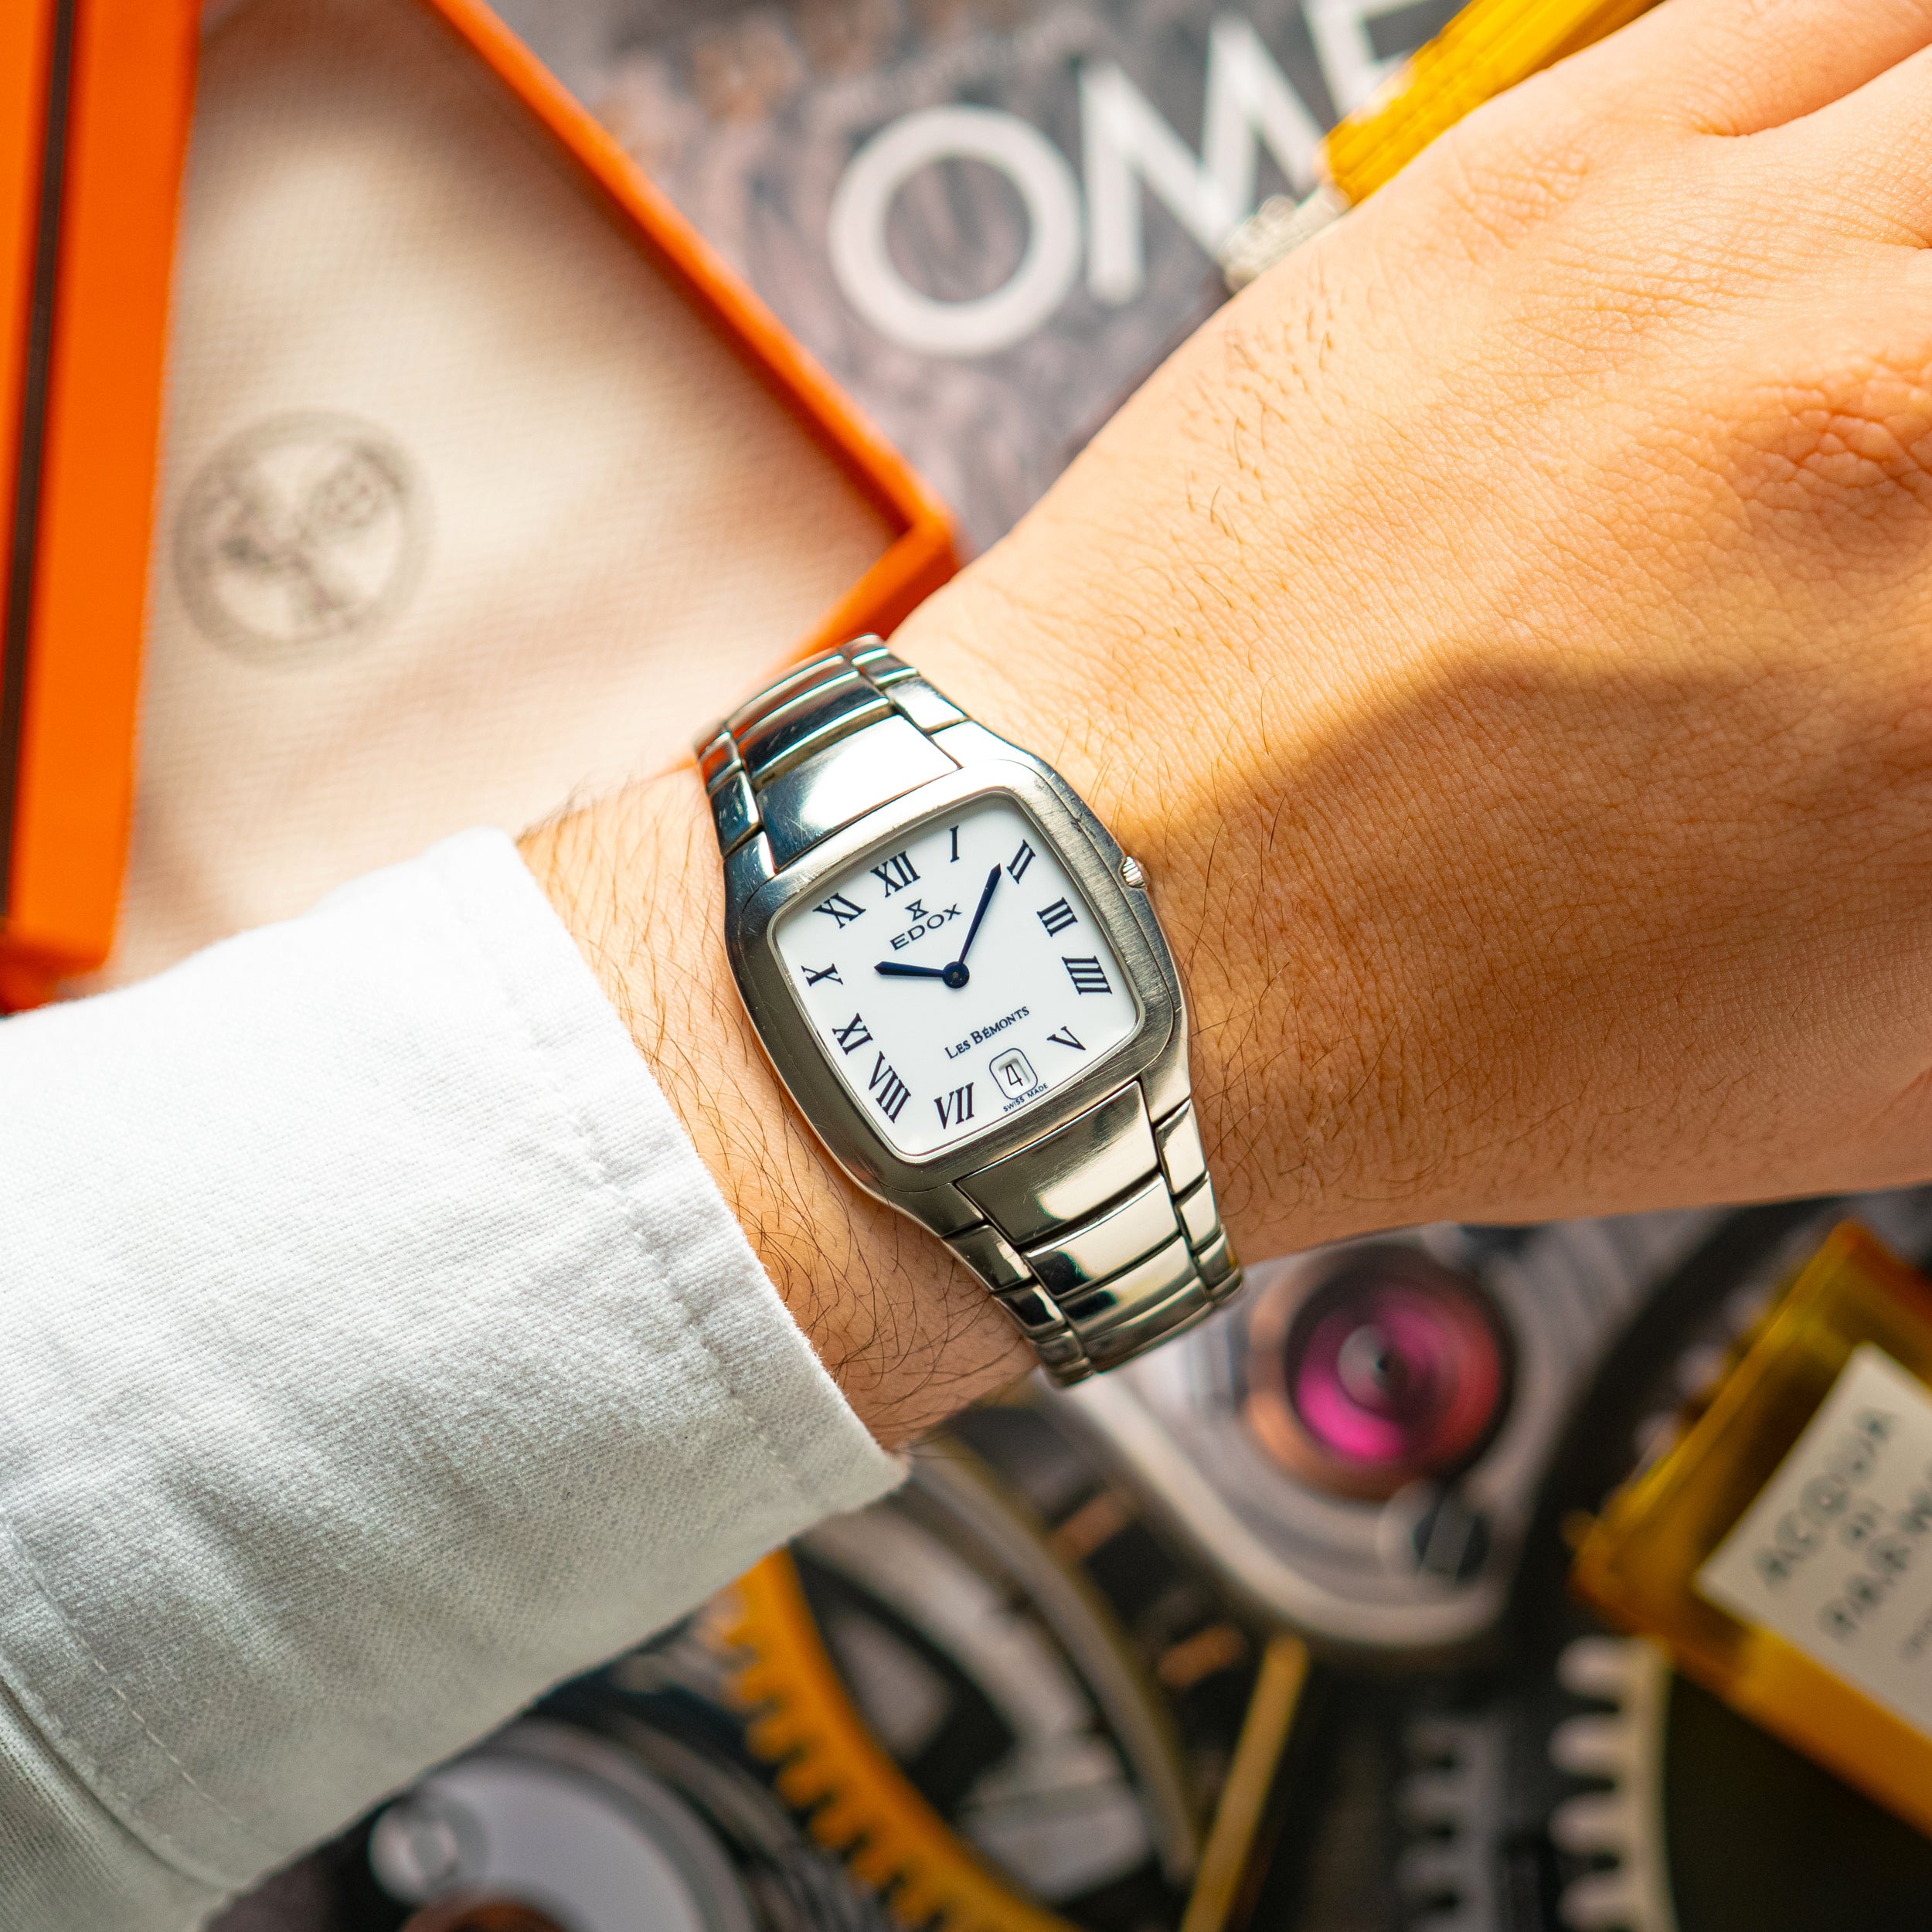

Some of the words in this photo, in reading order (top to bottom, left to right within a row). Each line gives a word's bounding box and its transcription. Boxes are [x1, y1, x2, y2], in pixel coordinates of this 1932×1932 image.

[869, 850, 921, 898] XII
[1006, 838, 1036, 885] II
[812, 893, 866, 929] XI
[889, 903, 963, 951] EDOX
[1036, 896, 1079, 938] III
[801, 963, 844, 988] X
[1061, 954, 1113, 995] IIII
[1046, 1026, 1087, 1051] V
[868, 1050, 912, 1124] VIII
[1005, 1063, 1024, 1087] 4
[933, 1081, 975, 1131] VII
[1002, 1096, 1026, 1112] SWISS
[1027, 1082, 1049, 1098] MADE
